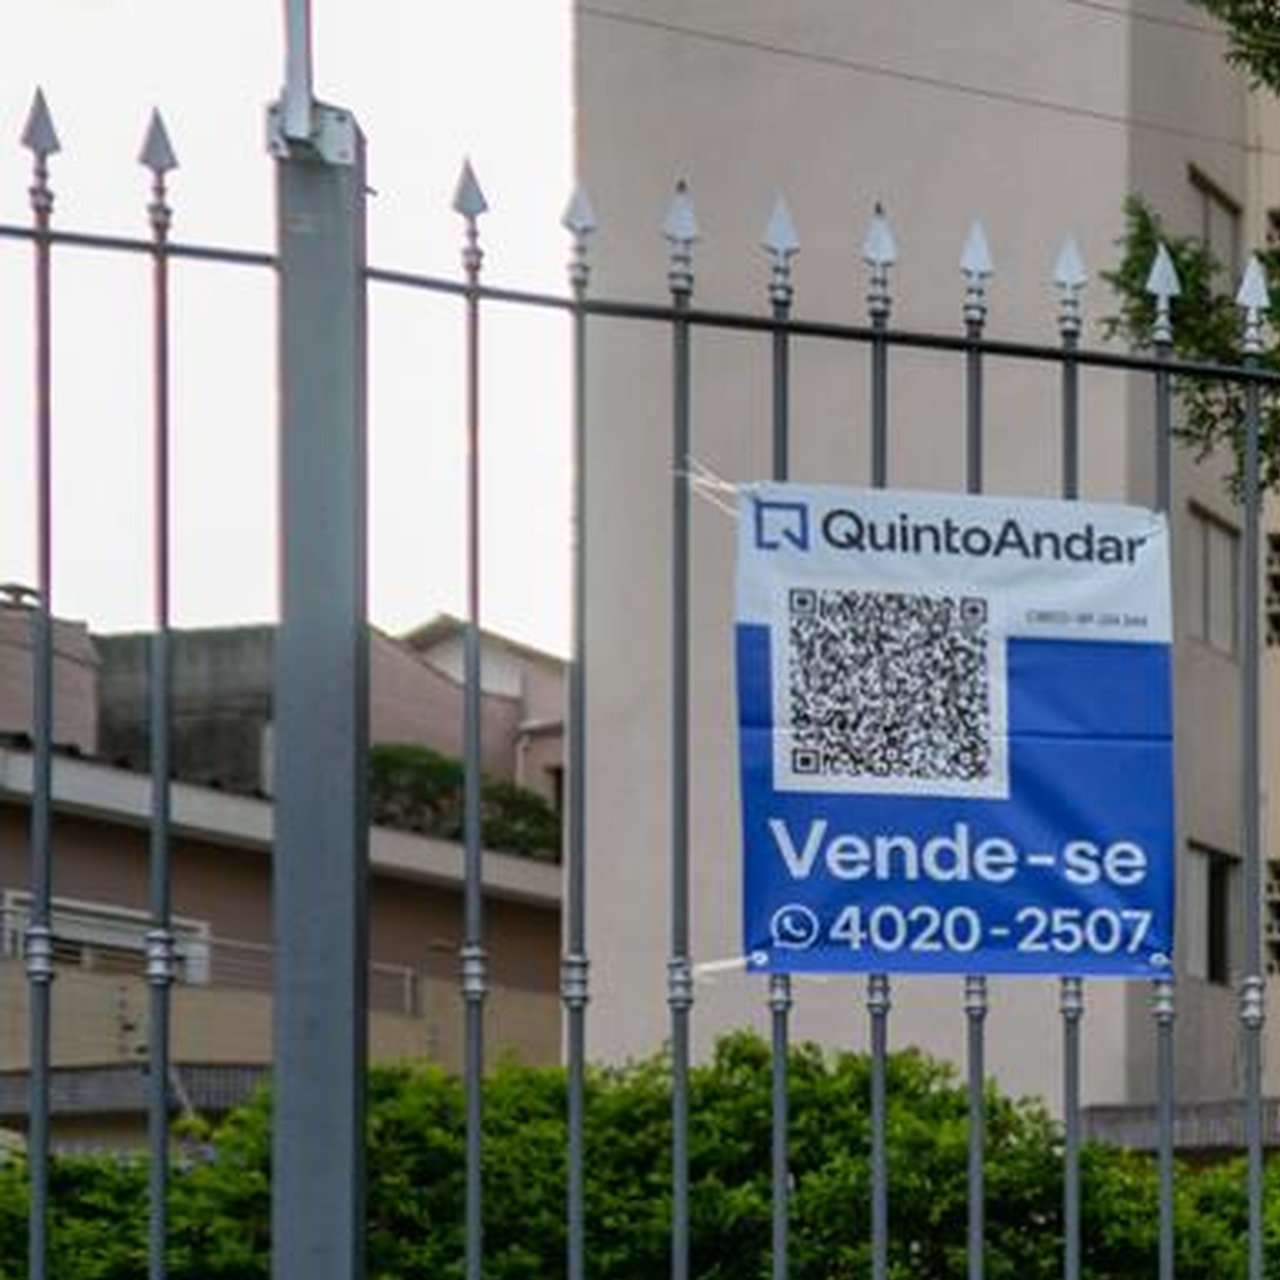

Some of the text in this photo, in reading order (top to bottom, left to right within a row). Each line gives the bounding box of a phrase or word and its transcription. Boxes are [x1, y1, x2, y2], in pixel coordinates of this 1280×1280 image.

[822, 509, 1148, 564] QuintoAndar
[769, 819, 1147, 885] Vende-se
[829, 905, 1153, 953] 4020-2507
